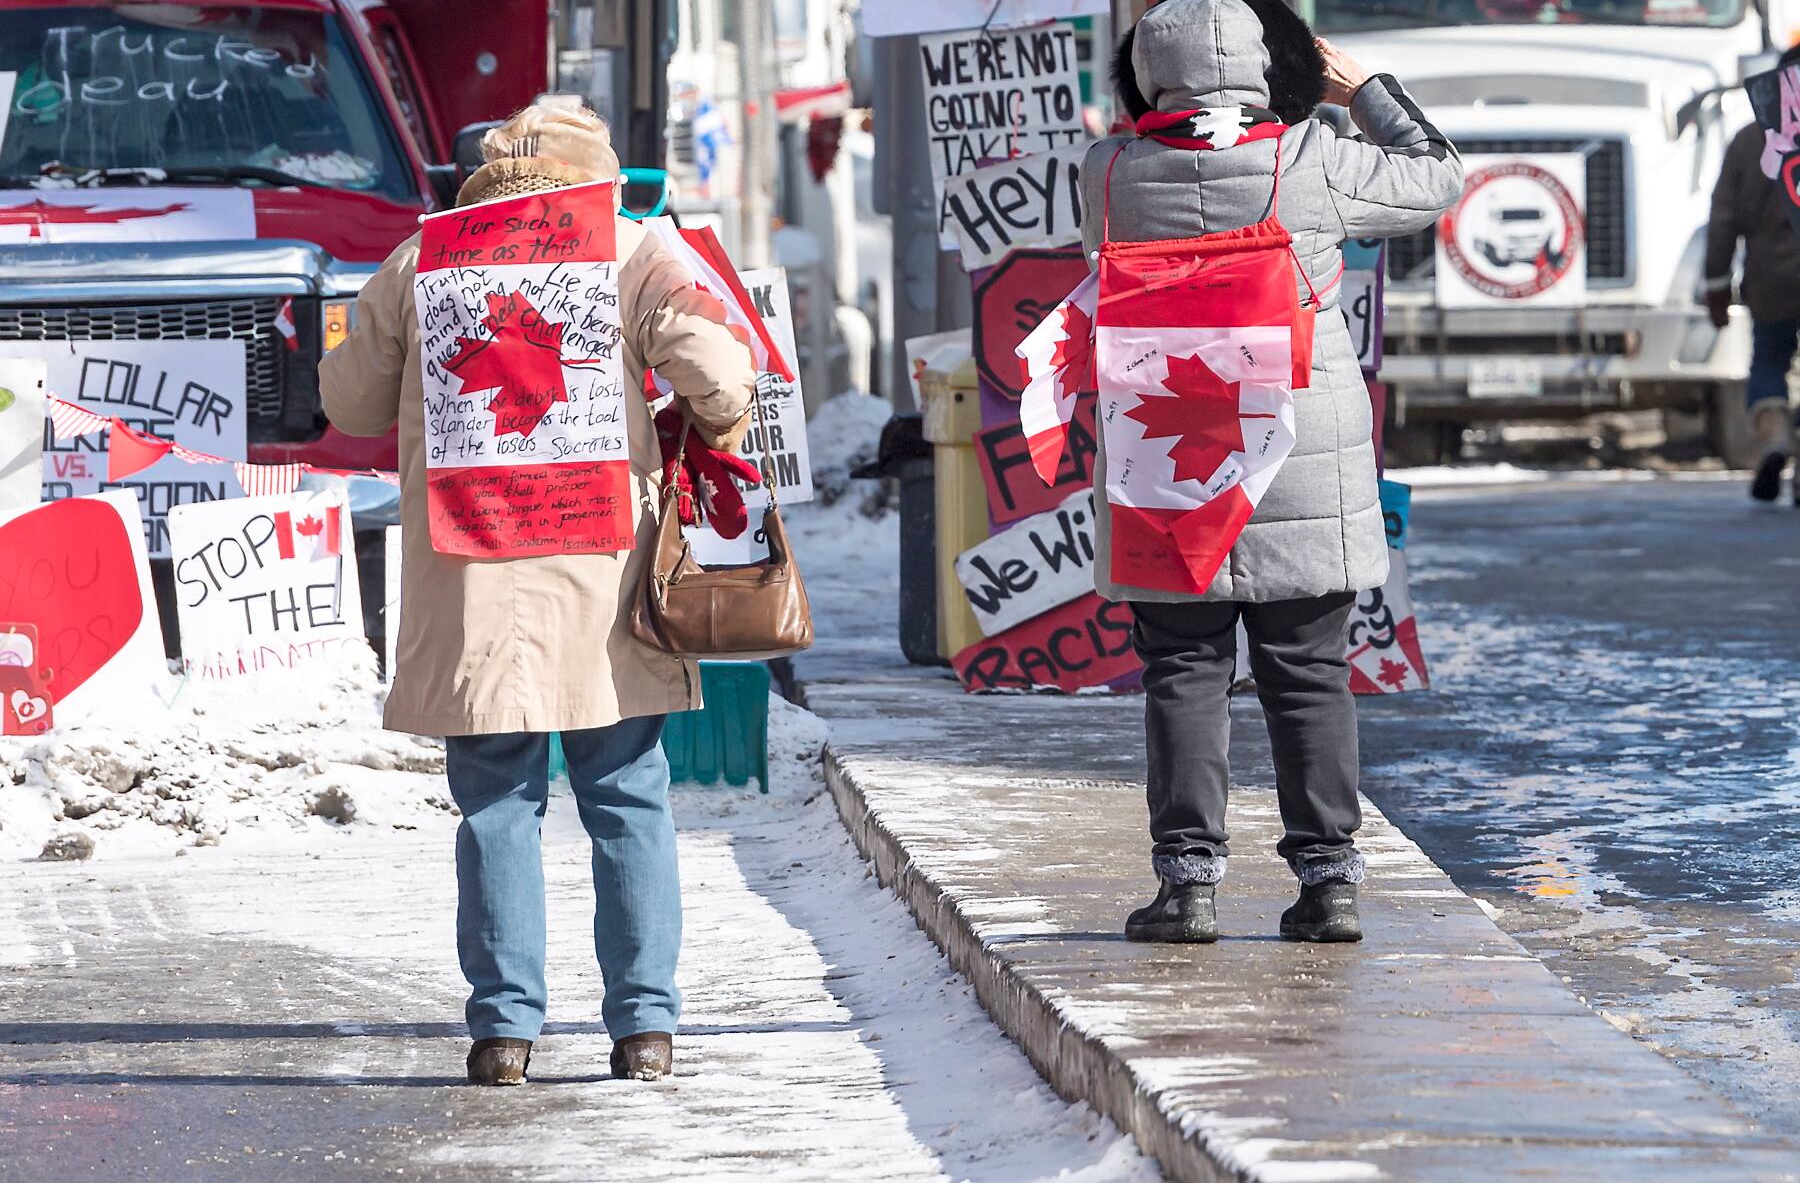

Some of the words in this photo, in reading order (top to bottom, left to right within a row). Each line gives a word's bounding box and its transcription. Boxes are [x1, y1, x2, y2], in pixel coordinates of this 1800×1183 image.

[921, 35, 1014, 86] WE'RE
[1014, 31, 1072, 78] NOT
[930, 89, 1027, 133] GOING
[1031, 84, 1074, 124] TO
[78, 358, 233, 436] COLLAR
[53, 454, 93, 478] VS.
[177, 514, 275, 608] STOP
[965, 554, 1038, 616] We
[229, 584, 345, 635] THE
